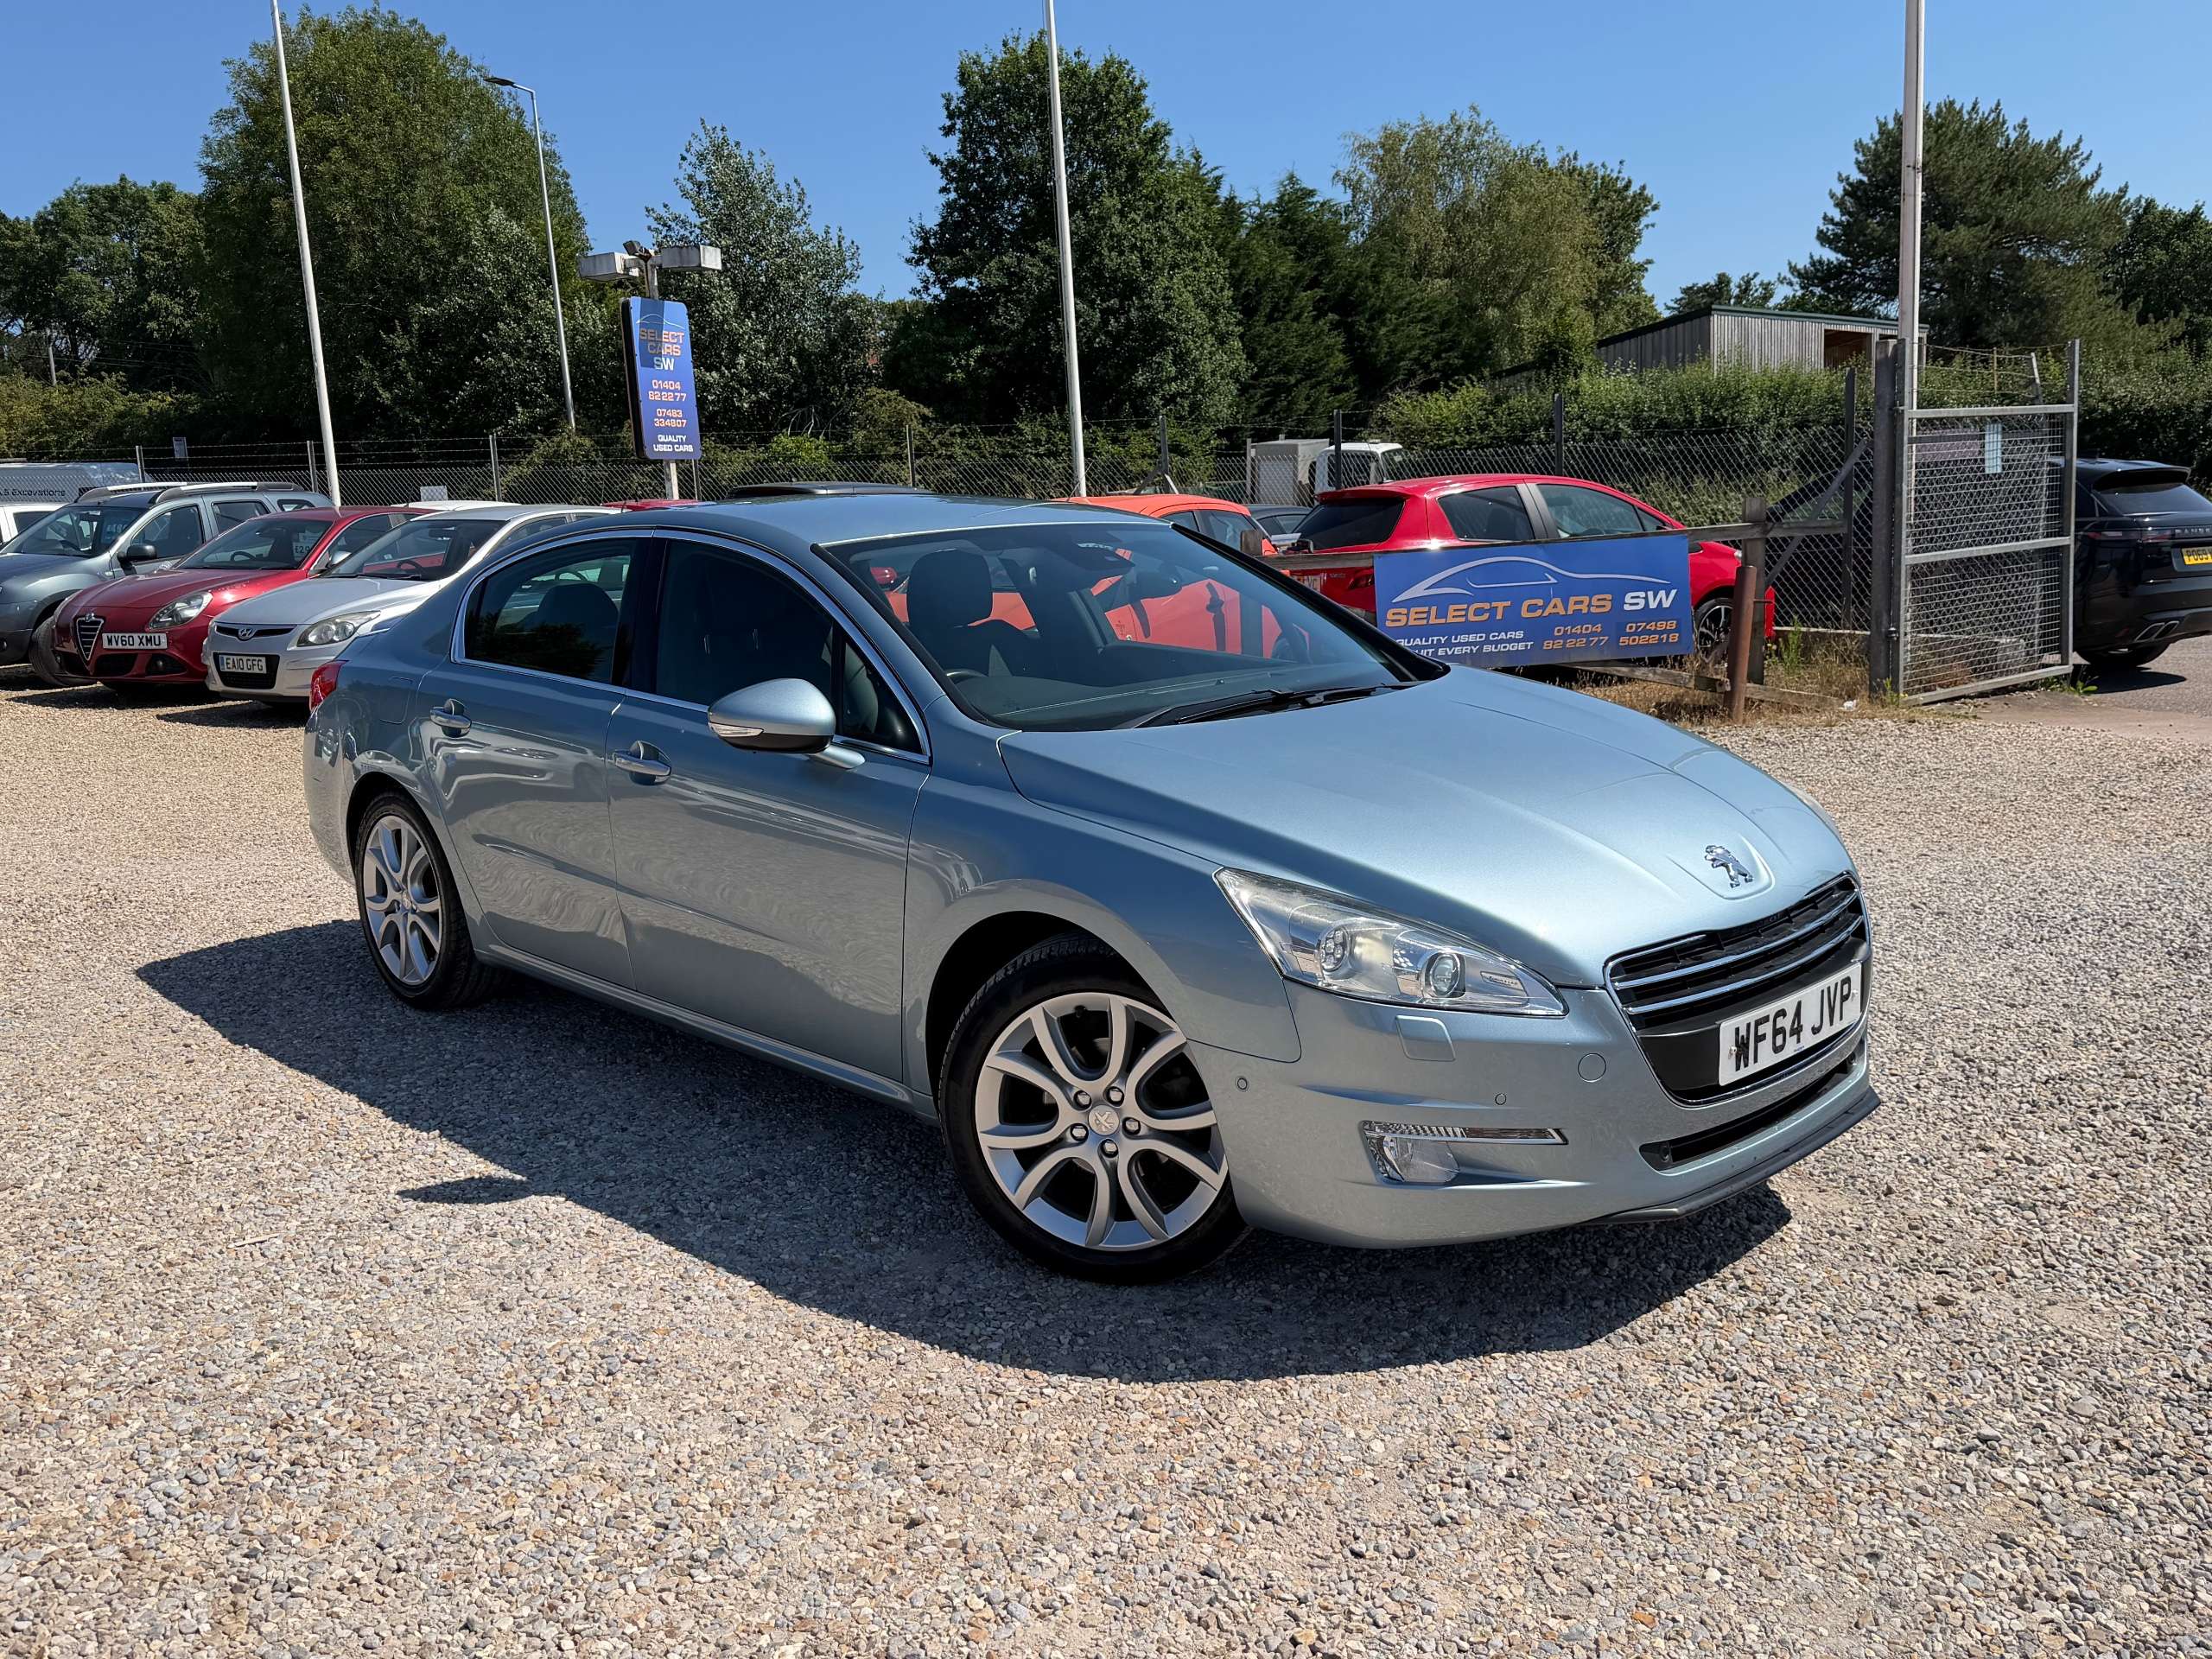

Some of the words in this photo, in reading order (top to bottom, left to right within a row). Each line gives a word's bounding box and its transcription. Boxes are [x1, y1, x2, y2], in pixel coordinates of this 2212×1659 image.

[640, 328, 684, 344] SELECT
[648, 342, 681, 358] CARS
[654, 357, 674, 371] SW
[652, 379, 681, 391] 01404
[658, 434, 687, 443] QUALITY
[674, 444, 694, 453] CARS
[1385, 601, 1511, 628] SELECT
[1521, 594, 1613, 619] CARS
[1623, 589, 1677, 612] SW
[1554, 623, 1603, 636] 01404
[1625, 620, 1678, 633] 07498
[107, 635, 134, 646] WV60
[137, 635, 162, 646] XMU
[1451, 633, 1486, 644] USED
[1489, 631, 1525, 640] CARS
[1618, 632, 1680, 646] 502218
[1437, 645, 1481, 656] EVERY
[1482, 642, 1535, 653] BUDGET
[1734, 1000, 1803, 1072] WF64
[1811, 976, 1852, 1036] JVP
